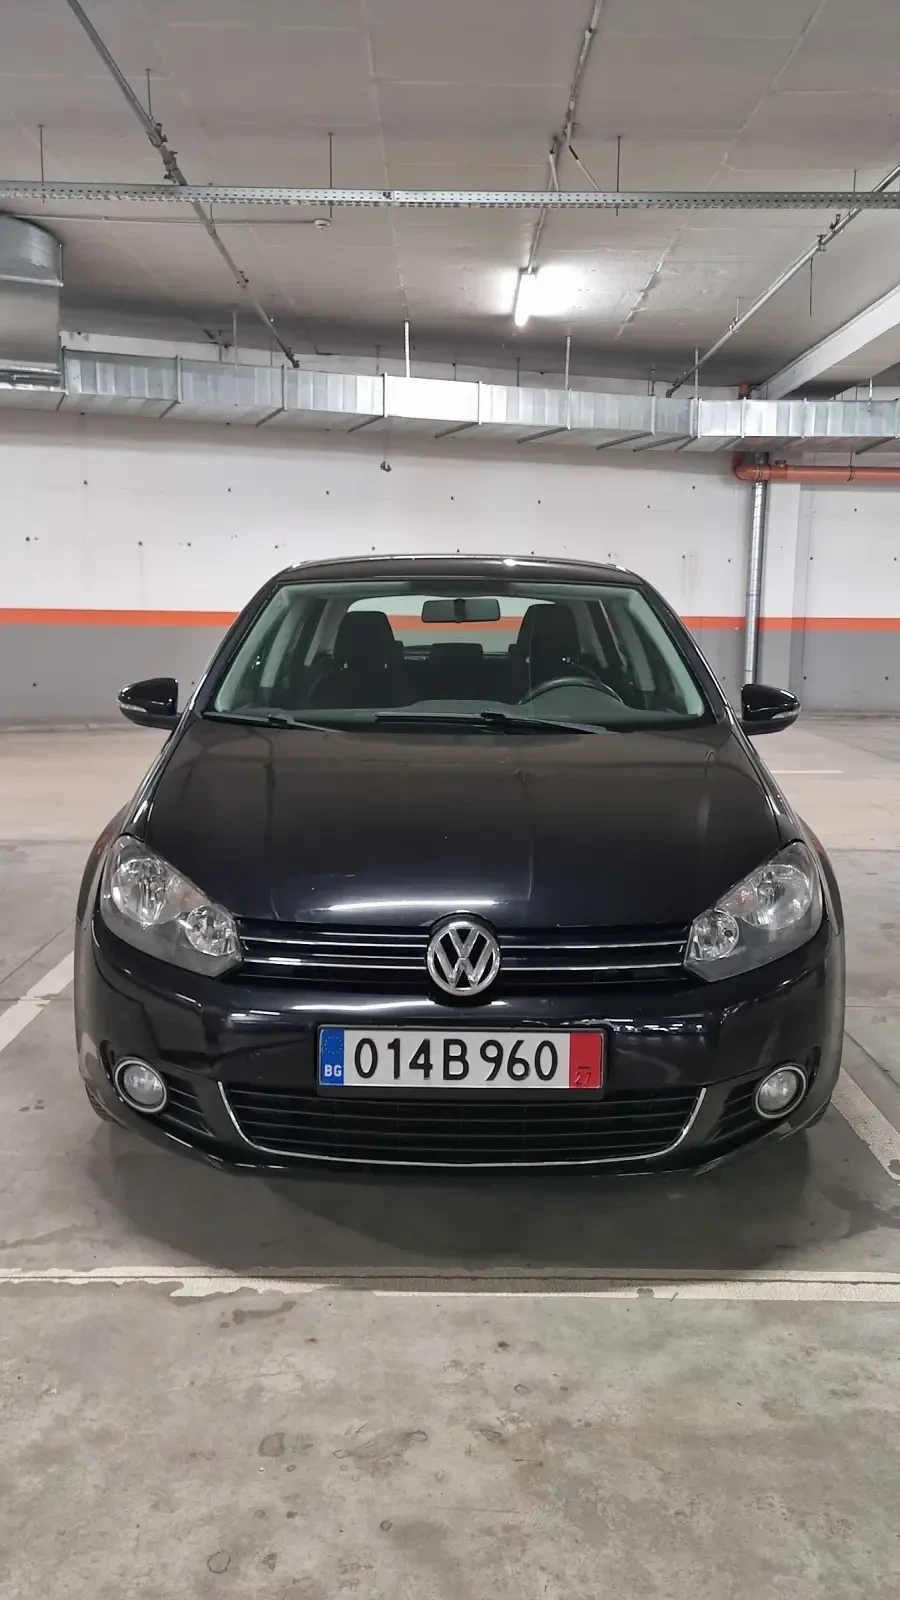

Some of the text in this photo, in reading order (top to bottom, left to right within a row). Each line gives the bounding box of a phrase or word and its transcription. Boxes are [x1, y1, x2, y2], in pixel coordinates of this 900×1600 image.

[430, 924, 495, 991] VW
[324, 1064, 342, 1077] BG
[354, 1038, 558, 1081] 014B960
